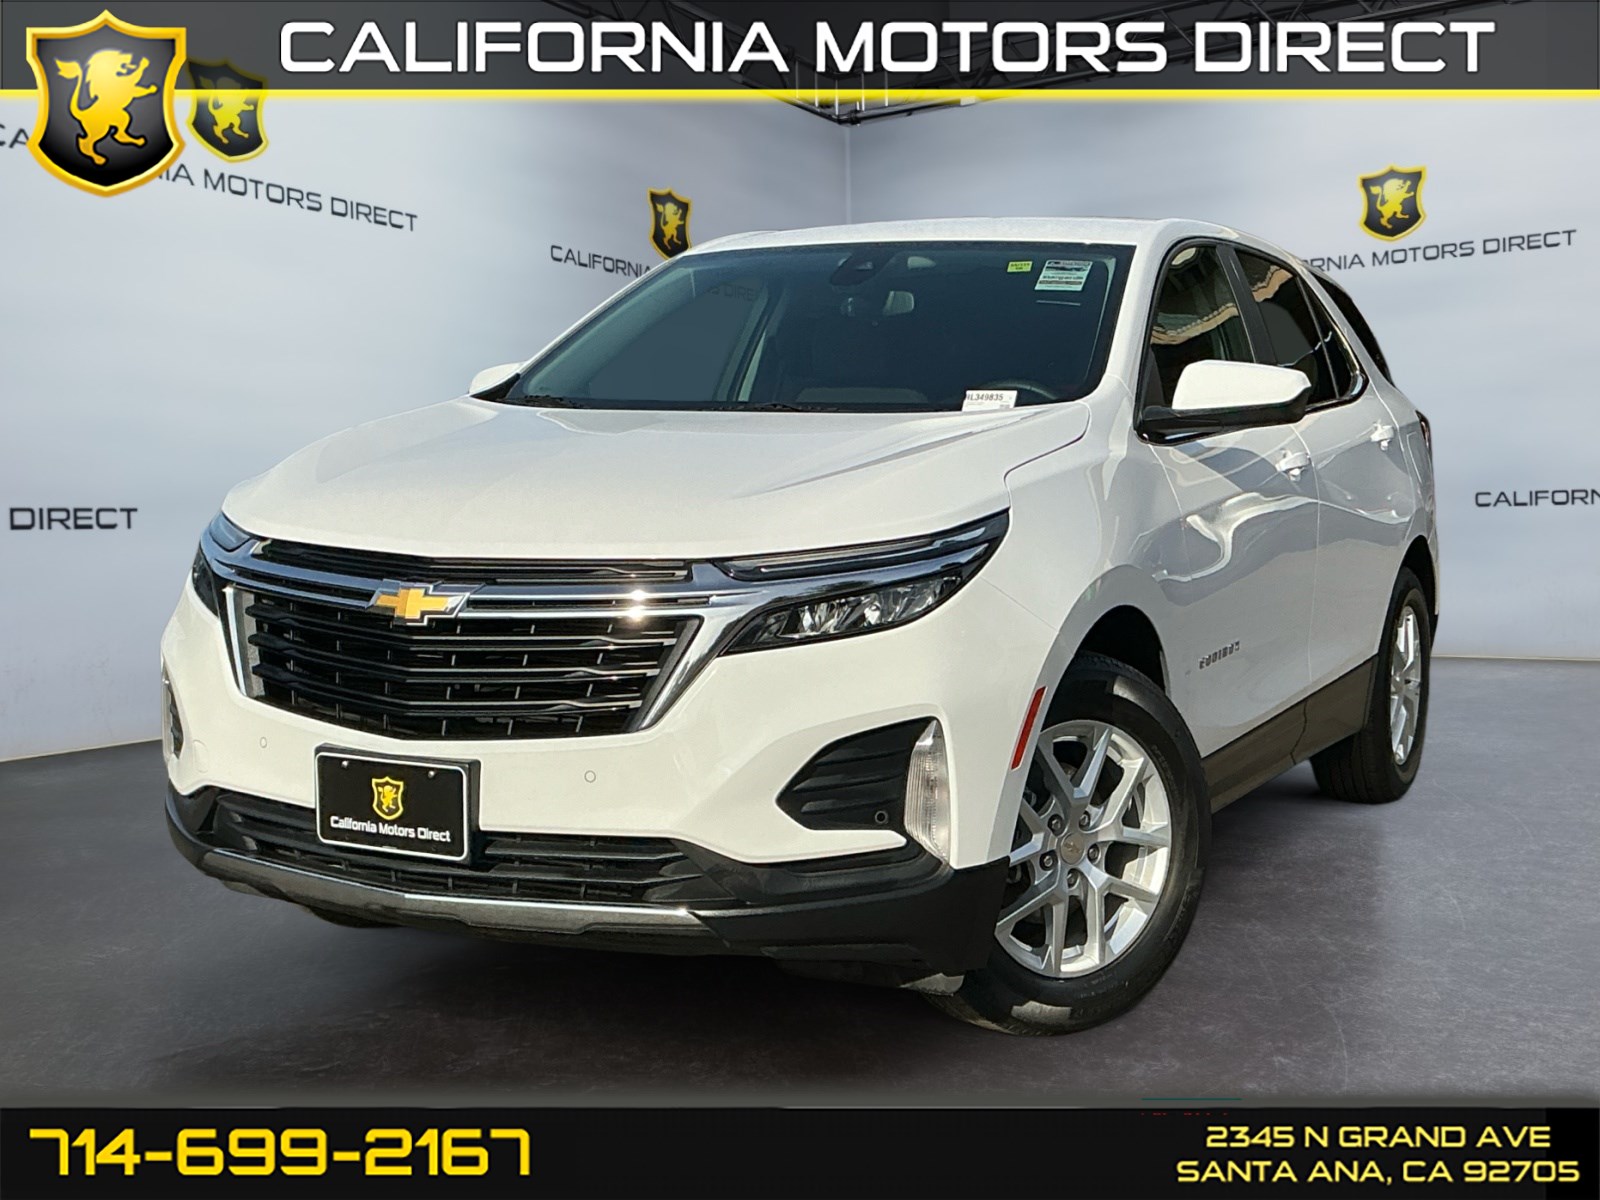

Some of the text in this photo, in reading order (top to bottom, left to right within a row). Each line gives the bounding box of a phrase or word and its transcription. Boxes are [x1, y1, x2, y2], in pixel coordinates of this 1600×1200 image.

[204, 169, 323, 212] MOTORS
[331, 196, 418, 232] DIRECT
[1372, 241, 1475, 266] MOTORS
[1483, 230, 1577, 254] DIRECT
[10, 507, 138, 530] DIRECT
[330, 816, 451, 842] California Motors Direct
